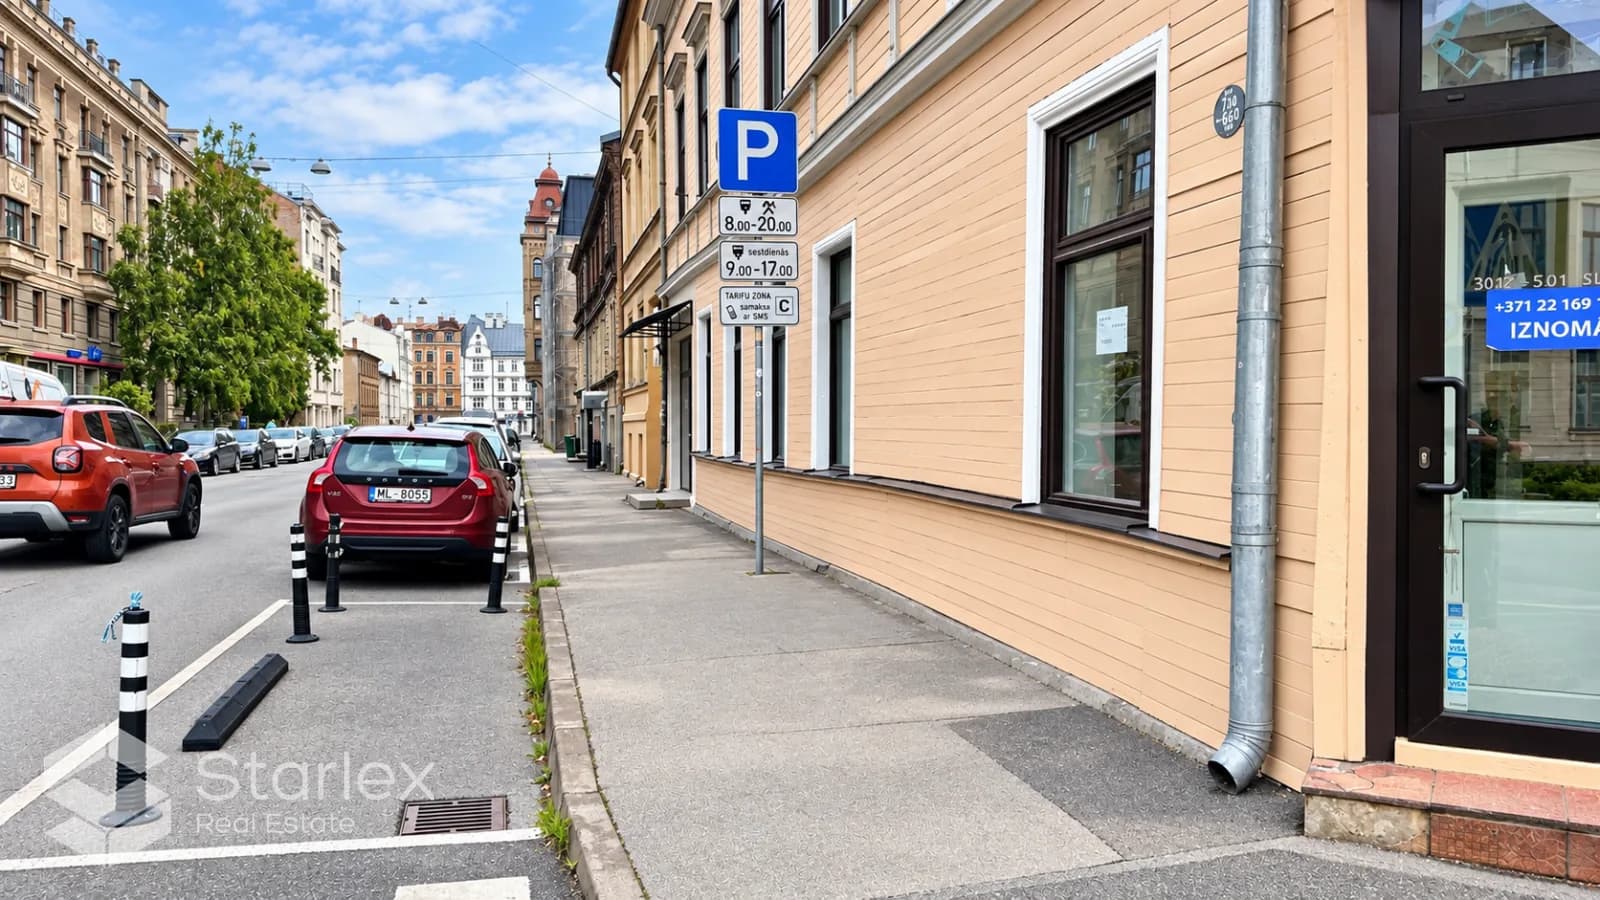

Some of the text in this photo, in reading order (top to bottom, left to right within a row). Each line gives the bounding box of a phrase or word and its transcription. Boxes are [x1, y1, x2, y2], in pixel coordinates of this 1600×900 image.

[737, 119, 779, 181] P
[779, 299, 790, 312] C
[1495, 300, 1531, 313] +371
[1537, 299, 1557, 311] 22
[1562, 297, 1592, 310] 169
